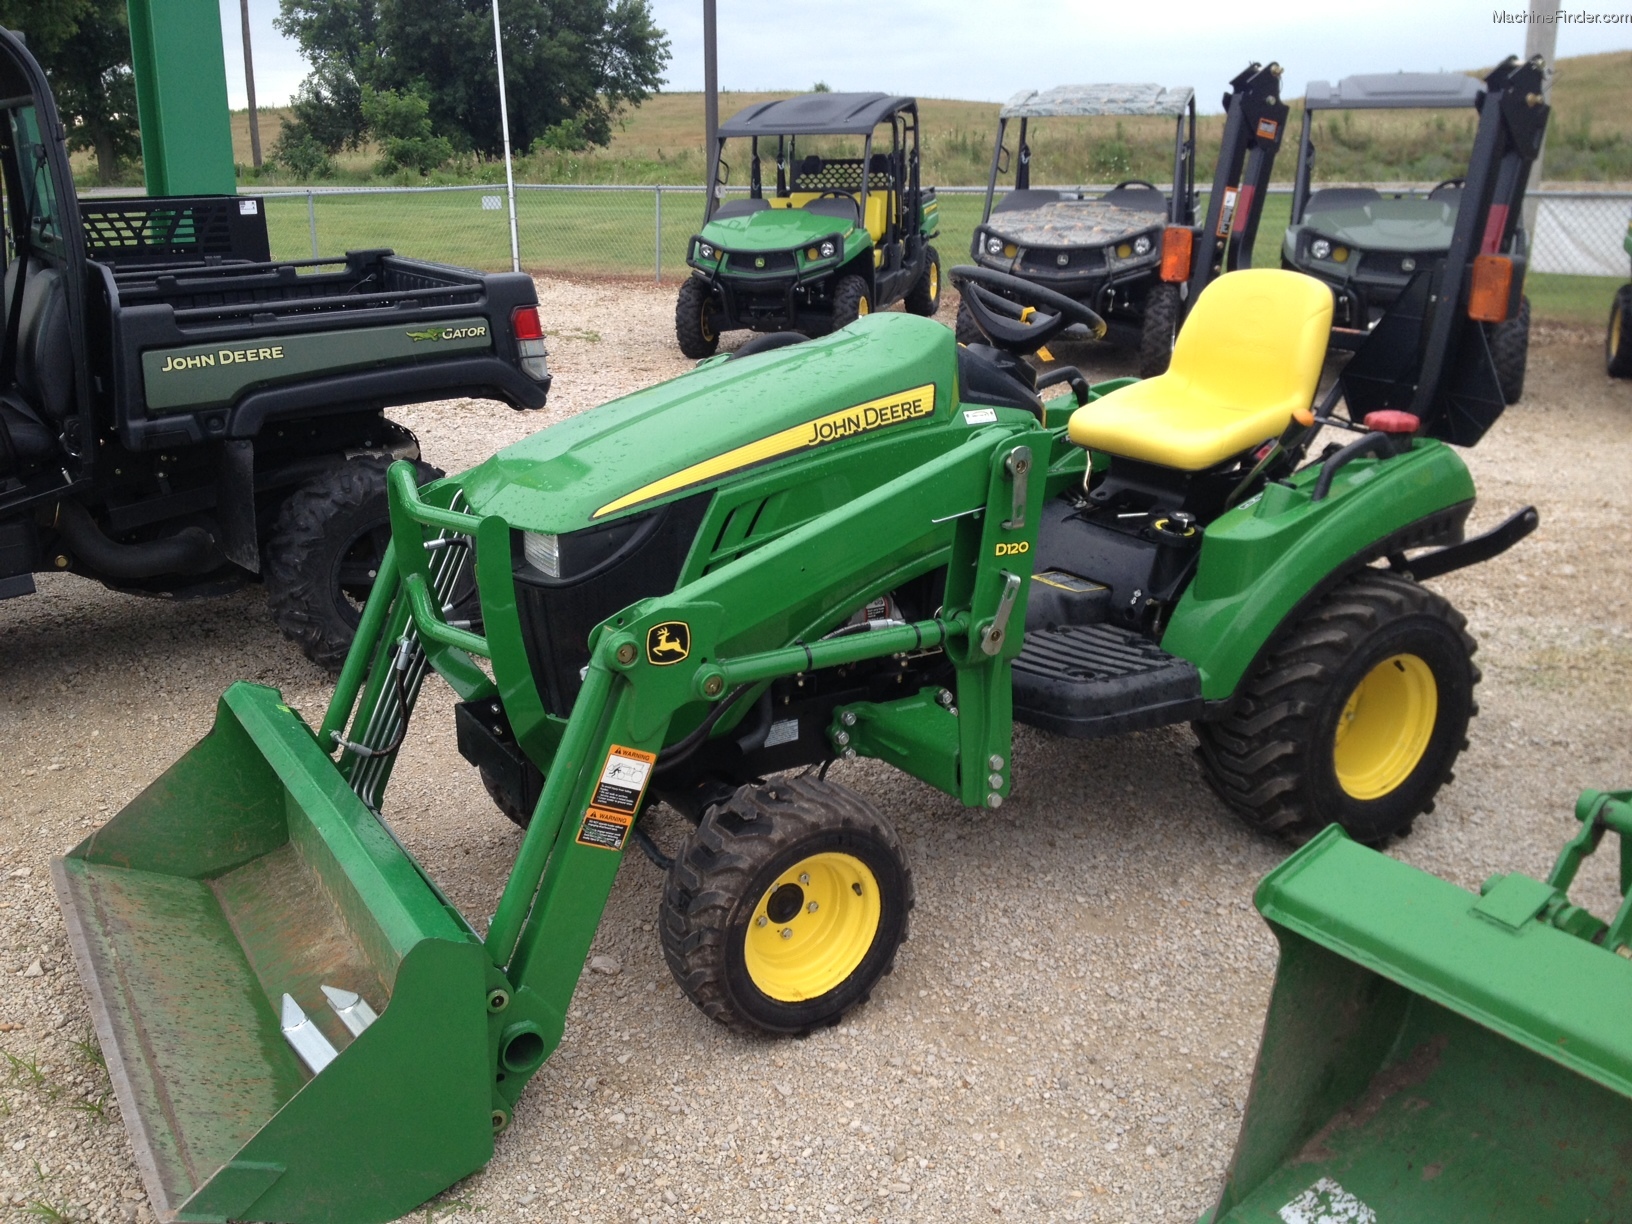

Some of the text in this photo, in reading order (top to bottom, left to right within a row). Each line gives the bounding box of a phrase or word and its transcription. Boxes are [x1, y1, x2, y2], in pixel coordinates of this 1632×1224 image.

[442, 326, 487, 340] GATOR
[162, 346, 284, 372] JOHN DEERE
[808, 399, 925, 444] JOHN DEERE
[995, 541, 1030, 556] D120
[622, 749, 650, 760] WARNING
[599, 813, 627, 824] WARNING
